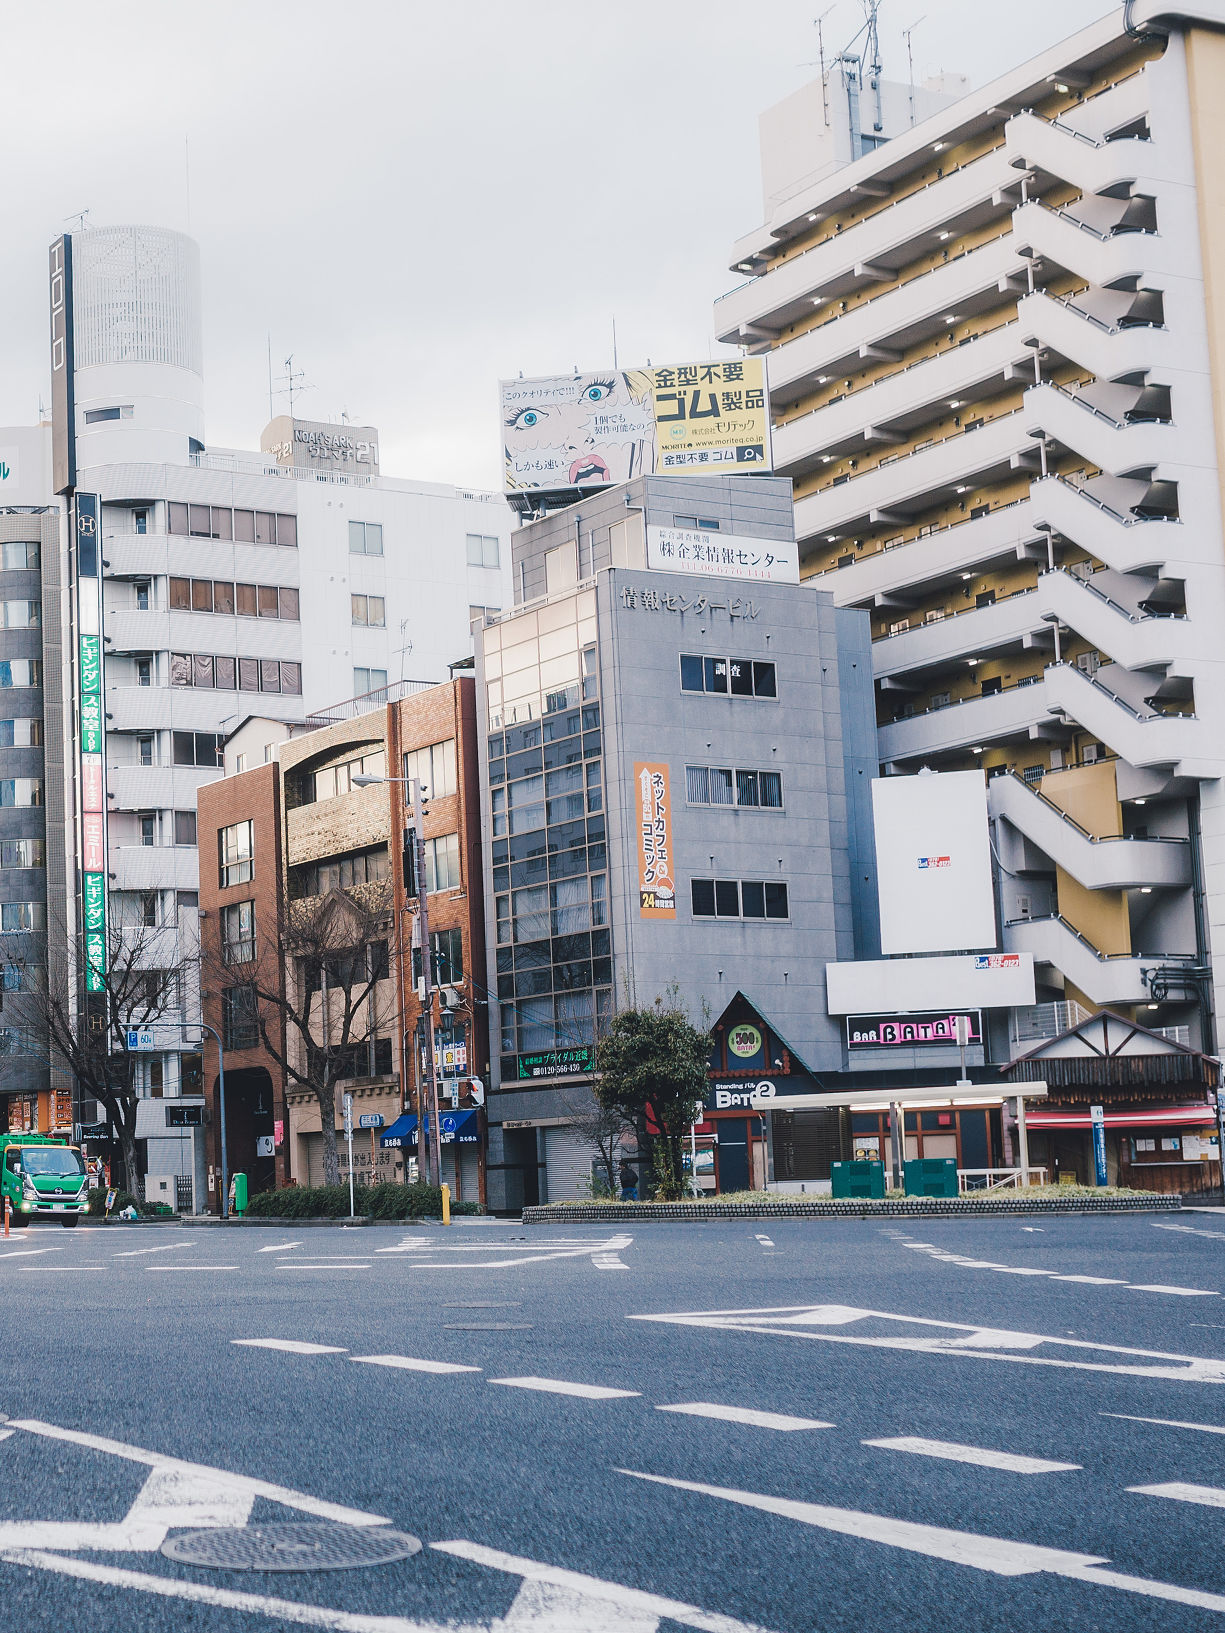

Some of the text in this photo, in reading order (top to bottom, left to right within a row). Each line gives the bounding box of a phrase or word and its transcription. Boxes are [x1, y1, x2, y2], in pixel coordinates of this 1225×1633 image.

[655, 362, 744, 389] 金型不要
[656, 389, 765, 422] ゴム製品
[332, 435, 353, 449] ARK
[695, 436, 764, 447] www.moriteq.co.jp
[356, 441, 379, 465] 21
[665, 450, 735, 466] 金型不要 ゴム
[620, 586, 762, 620] 情報センタービル
[715, 662, 741, 677] 調査
[643, 823, 655, 882] コミック
[735, 1032, 755, 1045] 500
